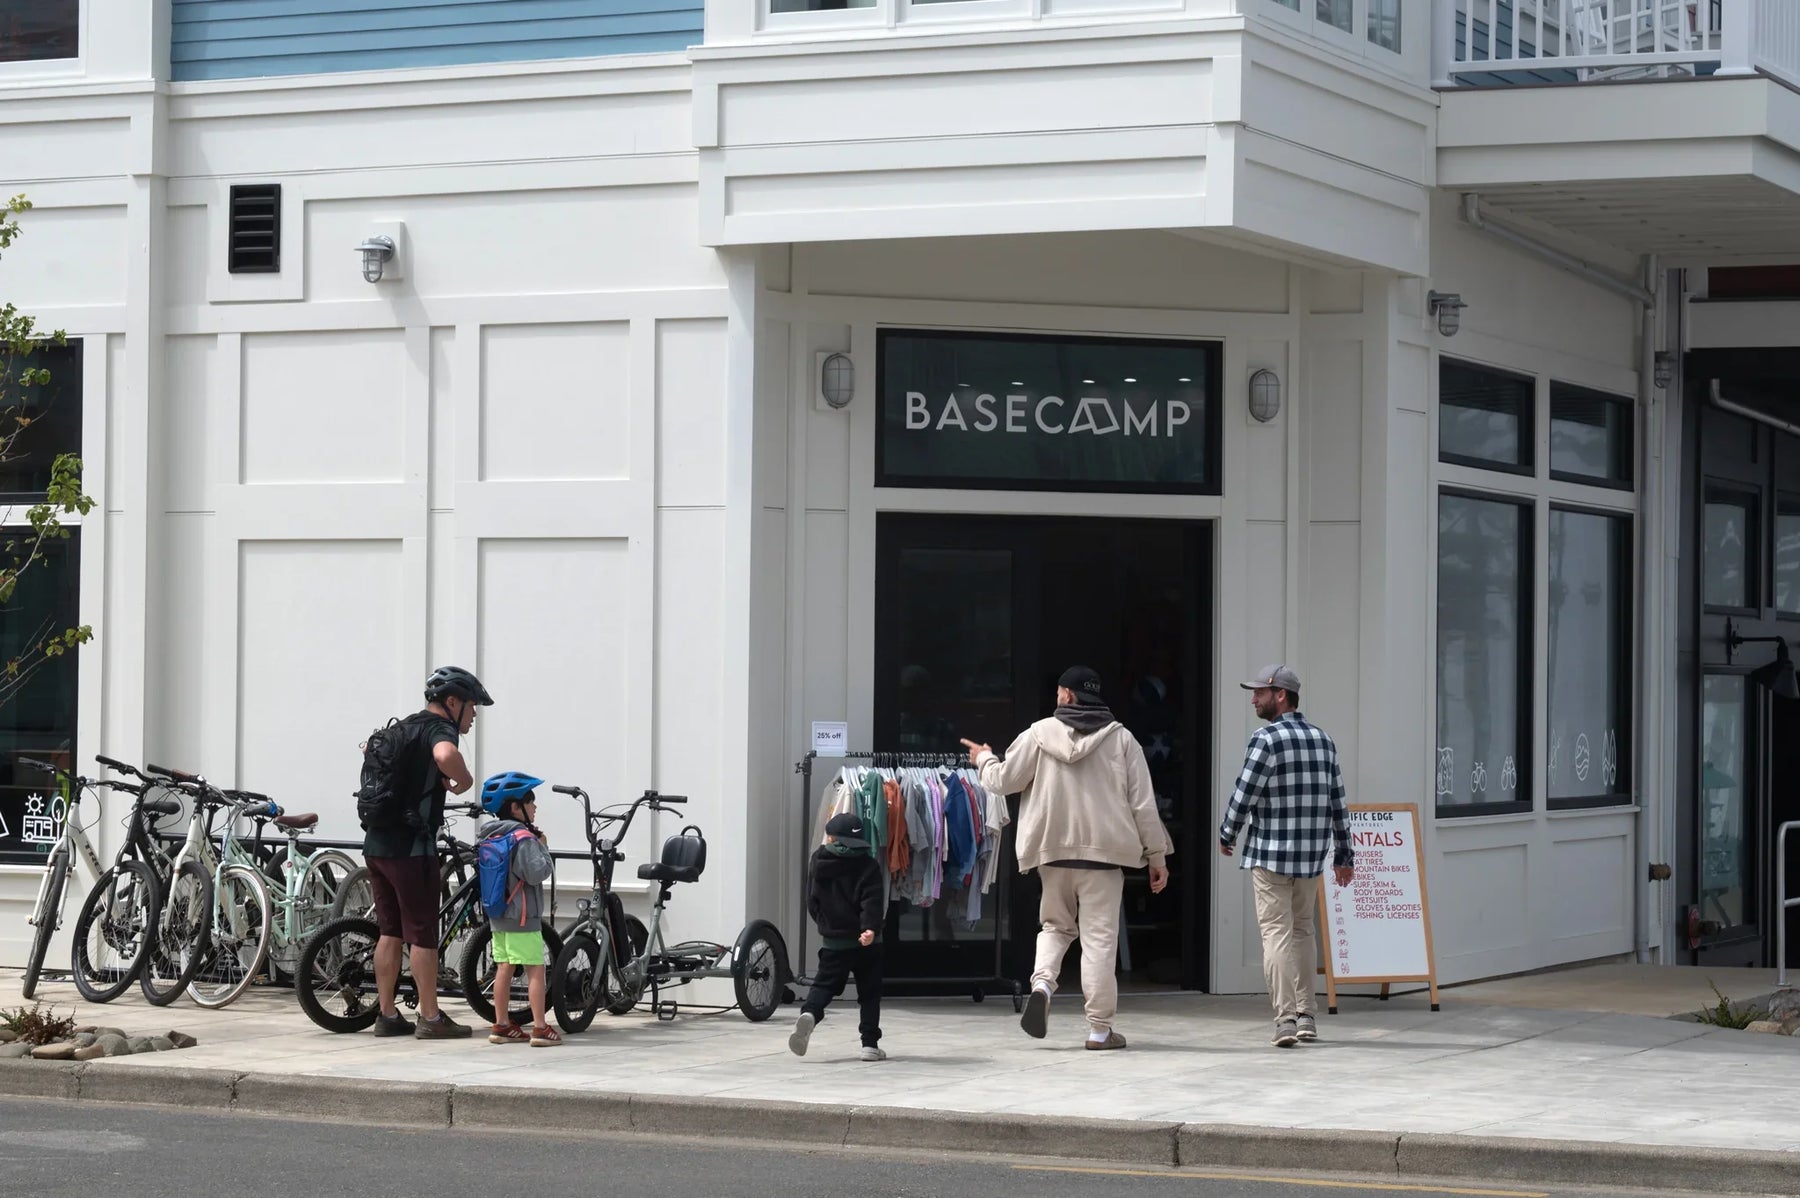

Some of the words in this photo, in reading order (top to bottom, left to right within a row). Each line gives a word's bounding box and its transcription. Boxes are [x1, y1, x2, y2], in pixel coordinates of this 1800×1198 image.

[906, 391, 1190, 437] BASECAMP
[1350, 812, 1368, 821] IFIC
[1371, 812, 1394, 821] EDGE
[1352, 831, 1404, 847] NTALS
[1354, 850, 1384, 858] RUISERS
[1365, 858, 1384, 866] TIRES
[1391, 865, 1411, 873] BIKES
[1373, 880, 1390, 888] SKIM
[1390, 880, 1396, 888] &
[1355, 904, 1384, 912] GLOVES
[1385, 904, 1391, 912] &
[1387, 911, 1420, 920] LICENSES
